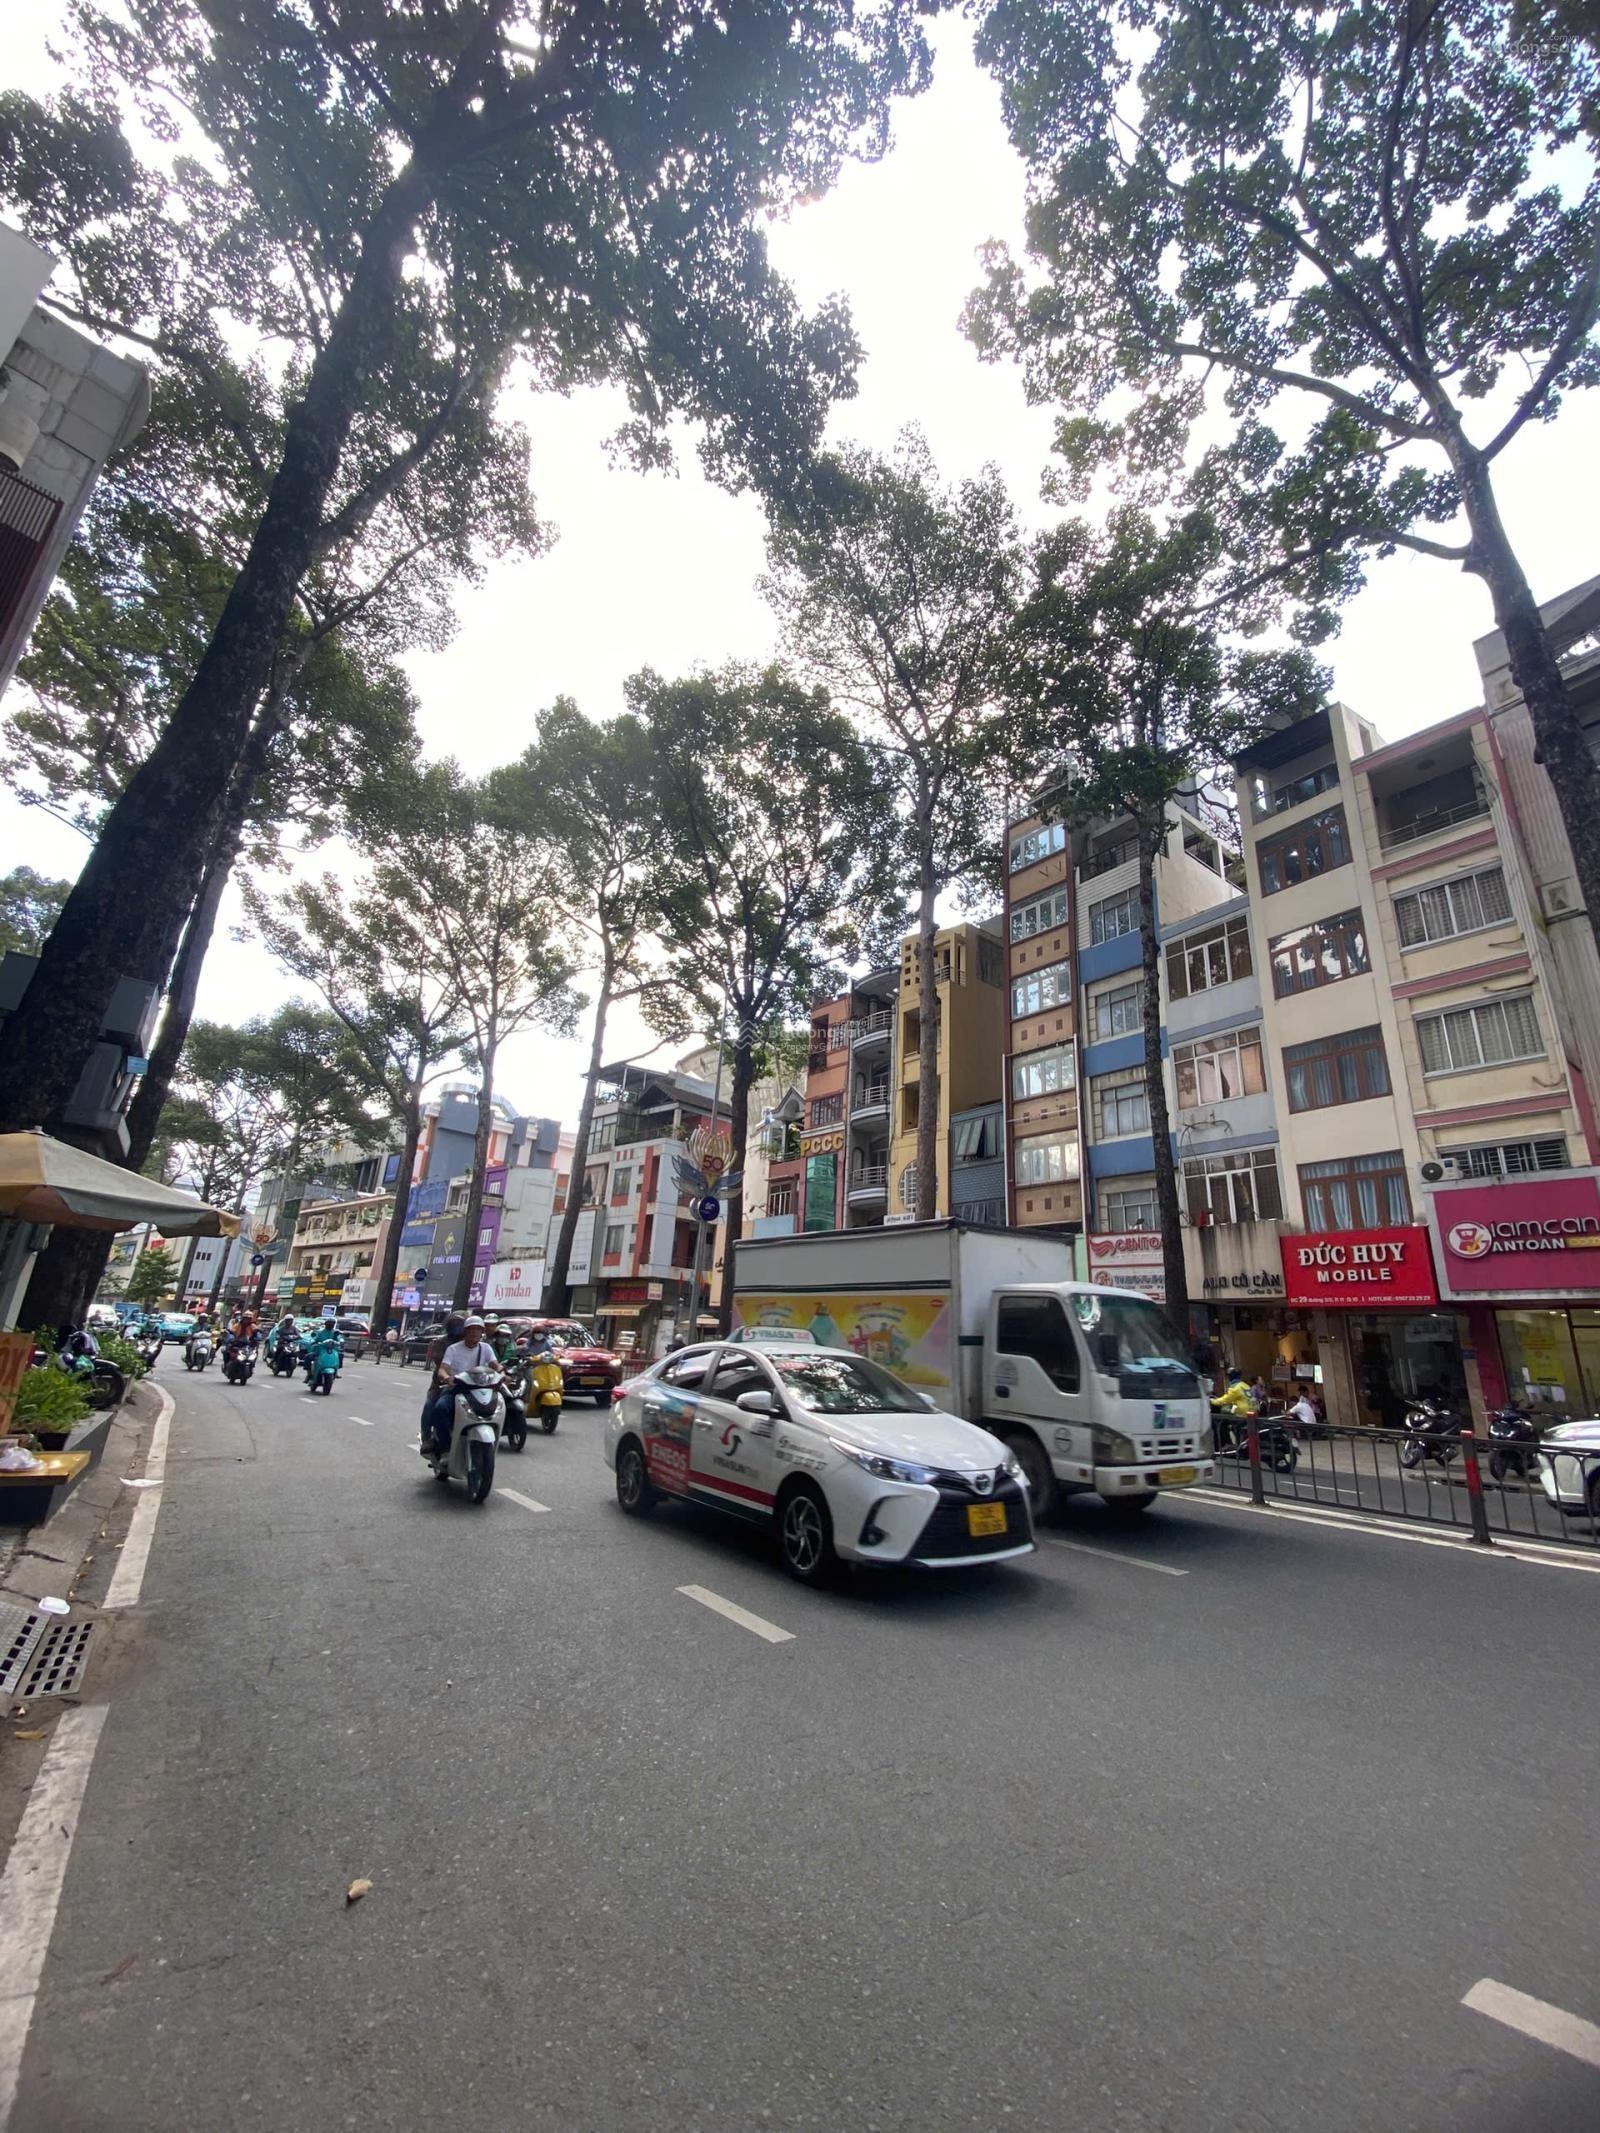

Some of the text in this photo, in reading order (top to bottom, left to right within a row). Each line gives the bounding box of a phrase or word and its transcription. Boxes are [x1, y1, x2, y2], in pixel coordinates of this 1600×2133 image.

[801, 1132, 844, 1156] PCCC
[702, 1154, 724, 1171] 50
[1491, 1237, 1566, 1252] ANTOAN
[1298, 1241, 1405, 1266] ĐỨC HUY
[1317, 1267, 1392, 1283] MOBILE
[495, 1283, 532, 1300] Kymdan
